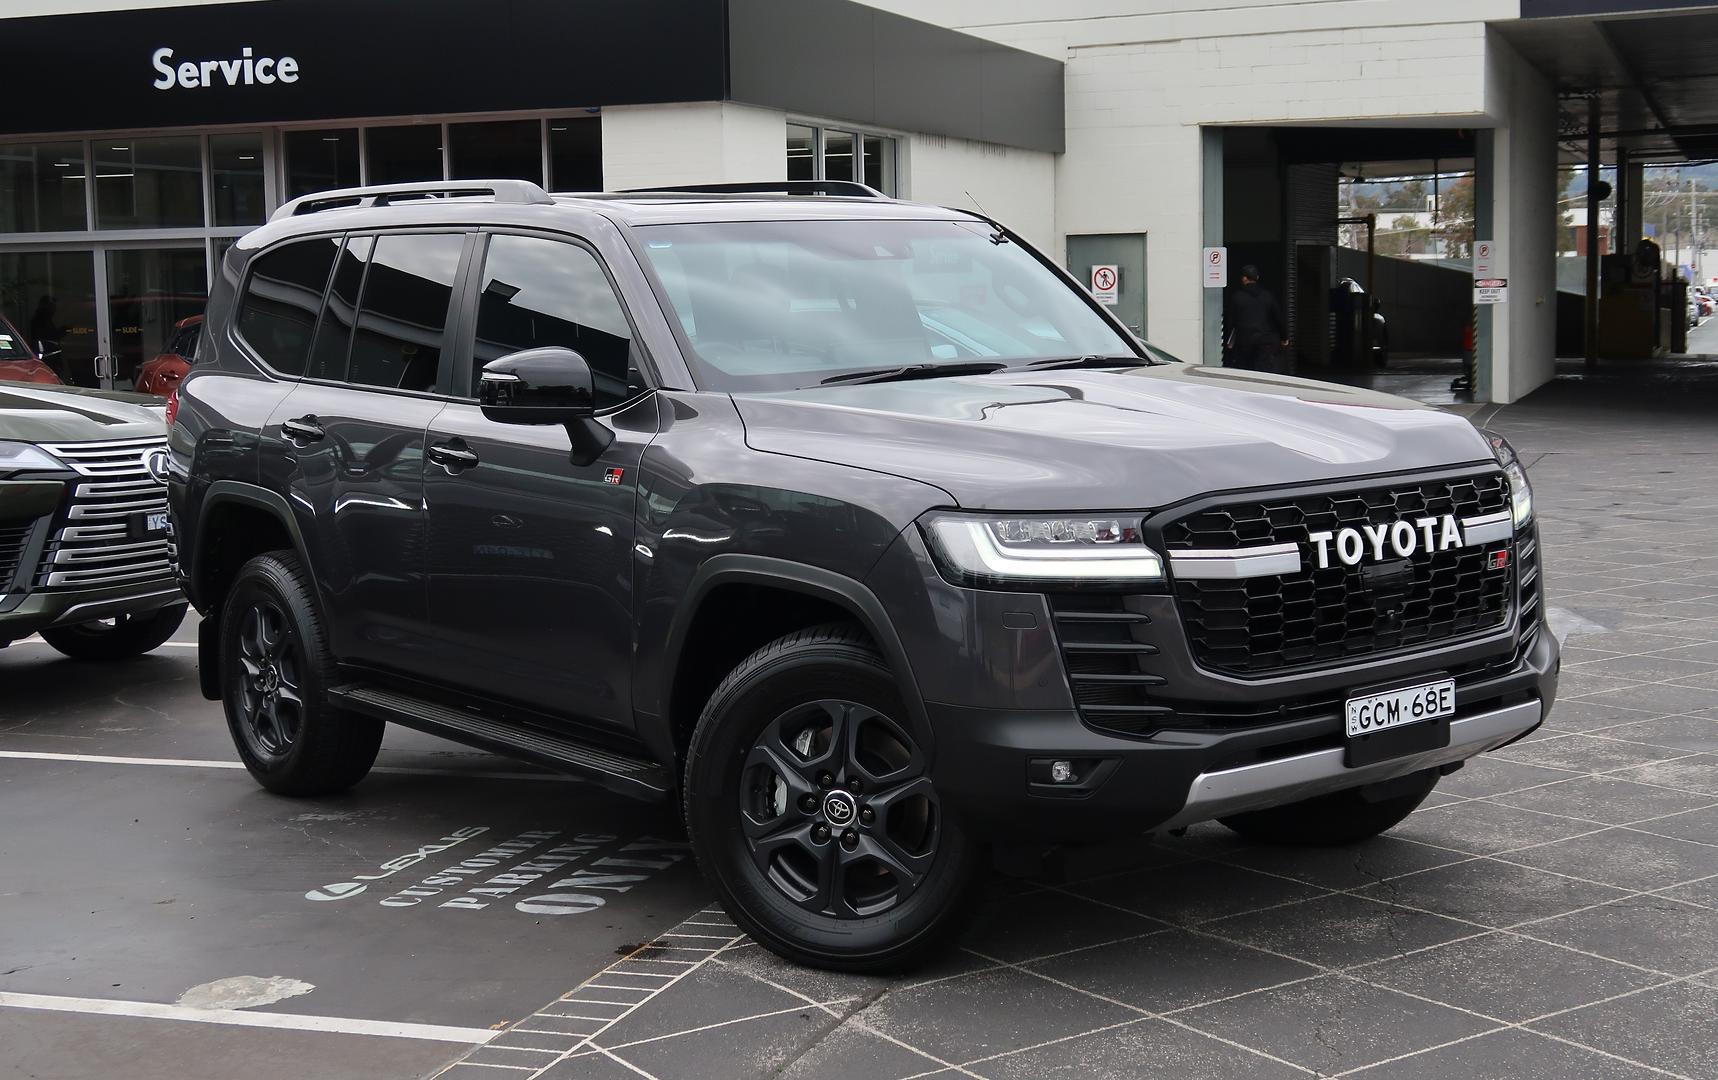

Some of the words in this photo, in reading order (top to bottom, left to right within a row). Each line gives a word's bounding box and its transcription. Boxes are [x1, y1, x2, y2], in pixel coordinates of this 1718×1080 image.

[152, 47, 299, 90] Service
[1309, 514, 1463, 569] TOYOTA
[353, 826, 490, 879] LEXUS
[379, 829, 562, 907] CUSTOMER
[438, 832, 617, 910] PARKING
[515, 836, 692, 915] ONLY
